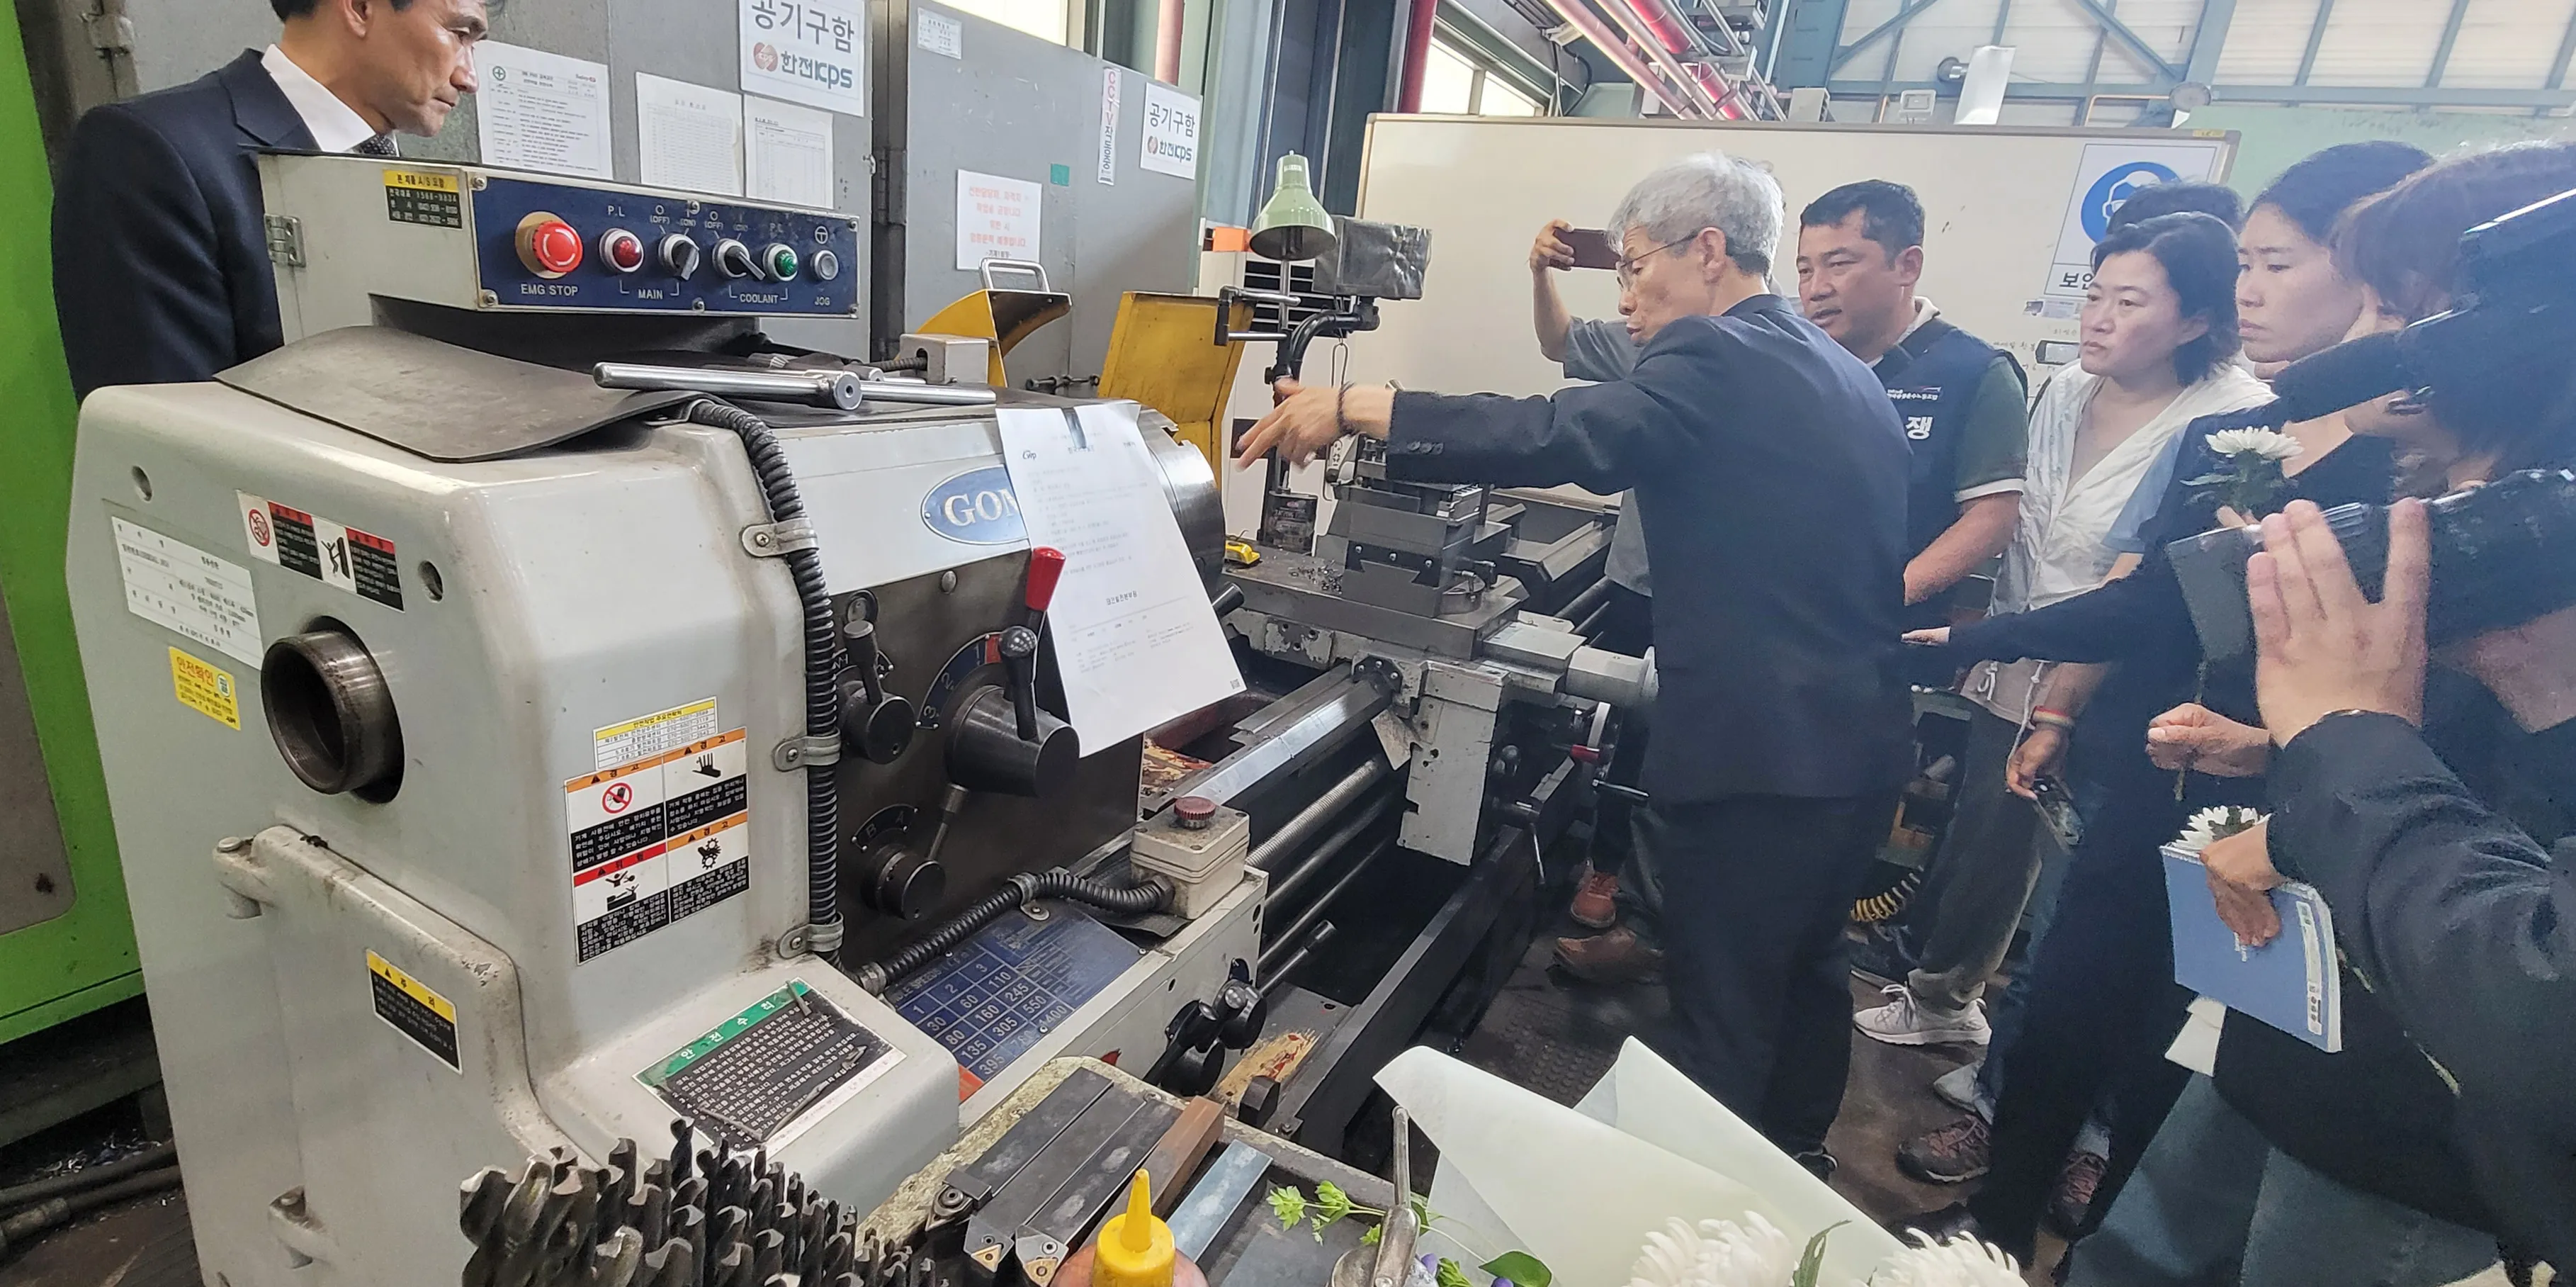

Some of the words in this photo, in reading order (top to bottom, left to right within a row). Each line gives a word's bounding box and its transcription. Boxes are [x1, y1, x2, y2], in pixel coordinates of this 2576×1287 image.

[1149, 103, 1195, 137] 공기구함
[608, 205, 625, 217] P.L
[650, 215, 670, 225] (OFF)
[704, 220, 723, 230] (OFF)
[521, 283, 546, 295] EMG
[549, 284, 578, 296] STOP
[638, 289, 663, 300] MAIN
[740, 293, 779, 304] COOLANT
[815, 296, 830, 306] JOG
[942, 673, 953, 690] 2
[924, 706, 935, 719] 3
[976, 963, 988, 973] 3
[944, 984, 959, 994] 2
[927, 1016, 947, 1030] 30
[959, 994, 978, 1008] 60
[988, 971, 1012, 988] 110
[913, 1006, 925, 1014] 1
[945, 1030, 966, 1045] 80
[974, 1004, 1000, 1023] 160
[1005, 983, 1029, 1002] 245
[961, 1042, 987, 1060] 135
[993, 1016, 1018, 1038] 305
[1022, 995, 1047, 1014] 550
[979, 1054, 1005, 1076] 395
[1039, 1005, 1068, 1027] 1400
[670, 1089, 683, 1098] 2.
[677, 1094, 690, 1103] 3.
[684, 1100, 696, 1109] 4.
[719, 1129, 730, 1138] 8.
[754, 1103, 769, 1114] 700
[712, 1122, 725, 1132] 7.
